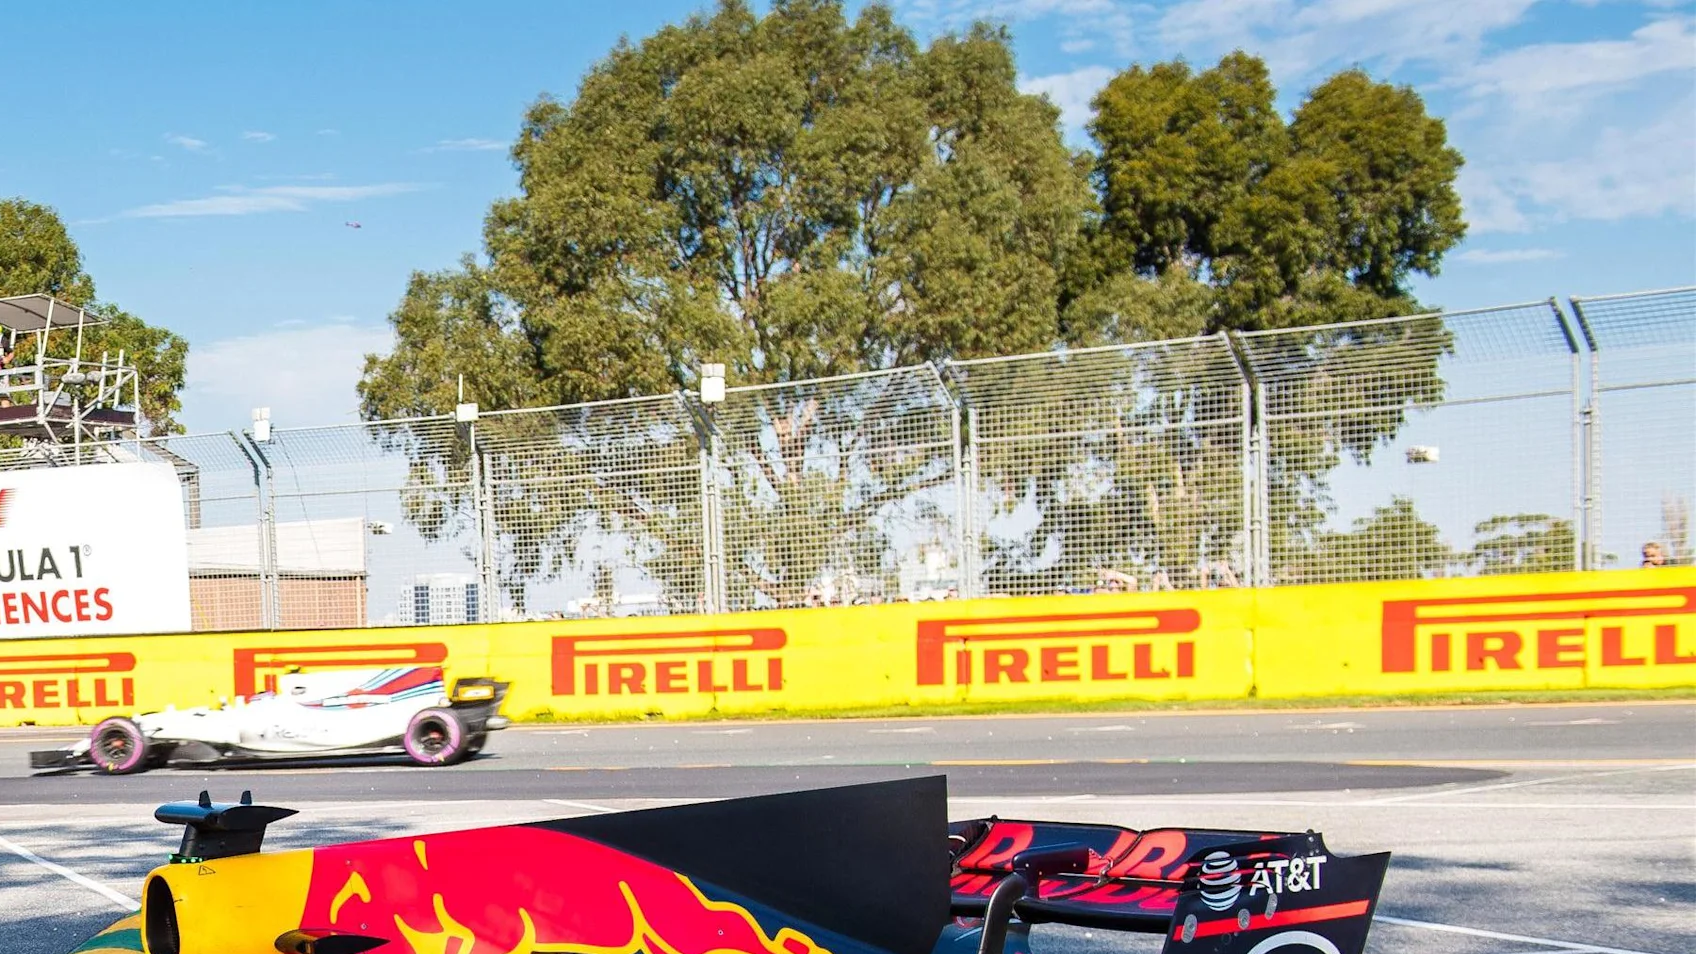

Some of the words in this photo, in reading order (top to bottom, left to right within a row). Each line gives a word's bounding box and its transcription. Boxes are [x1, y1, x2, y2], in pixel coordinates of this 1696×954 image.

[552, 628, 786, 696] PIRELLI
[917, 608, 1200, 685] PIRELLI
[1382, 586, 1696, 672] PIRELL
[1248, 855, 1327, 896] AT&T
